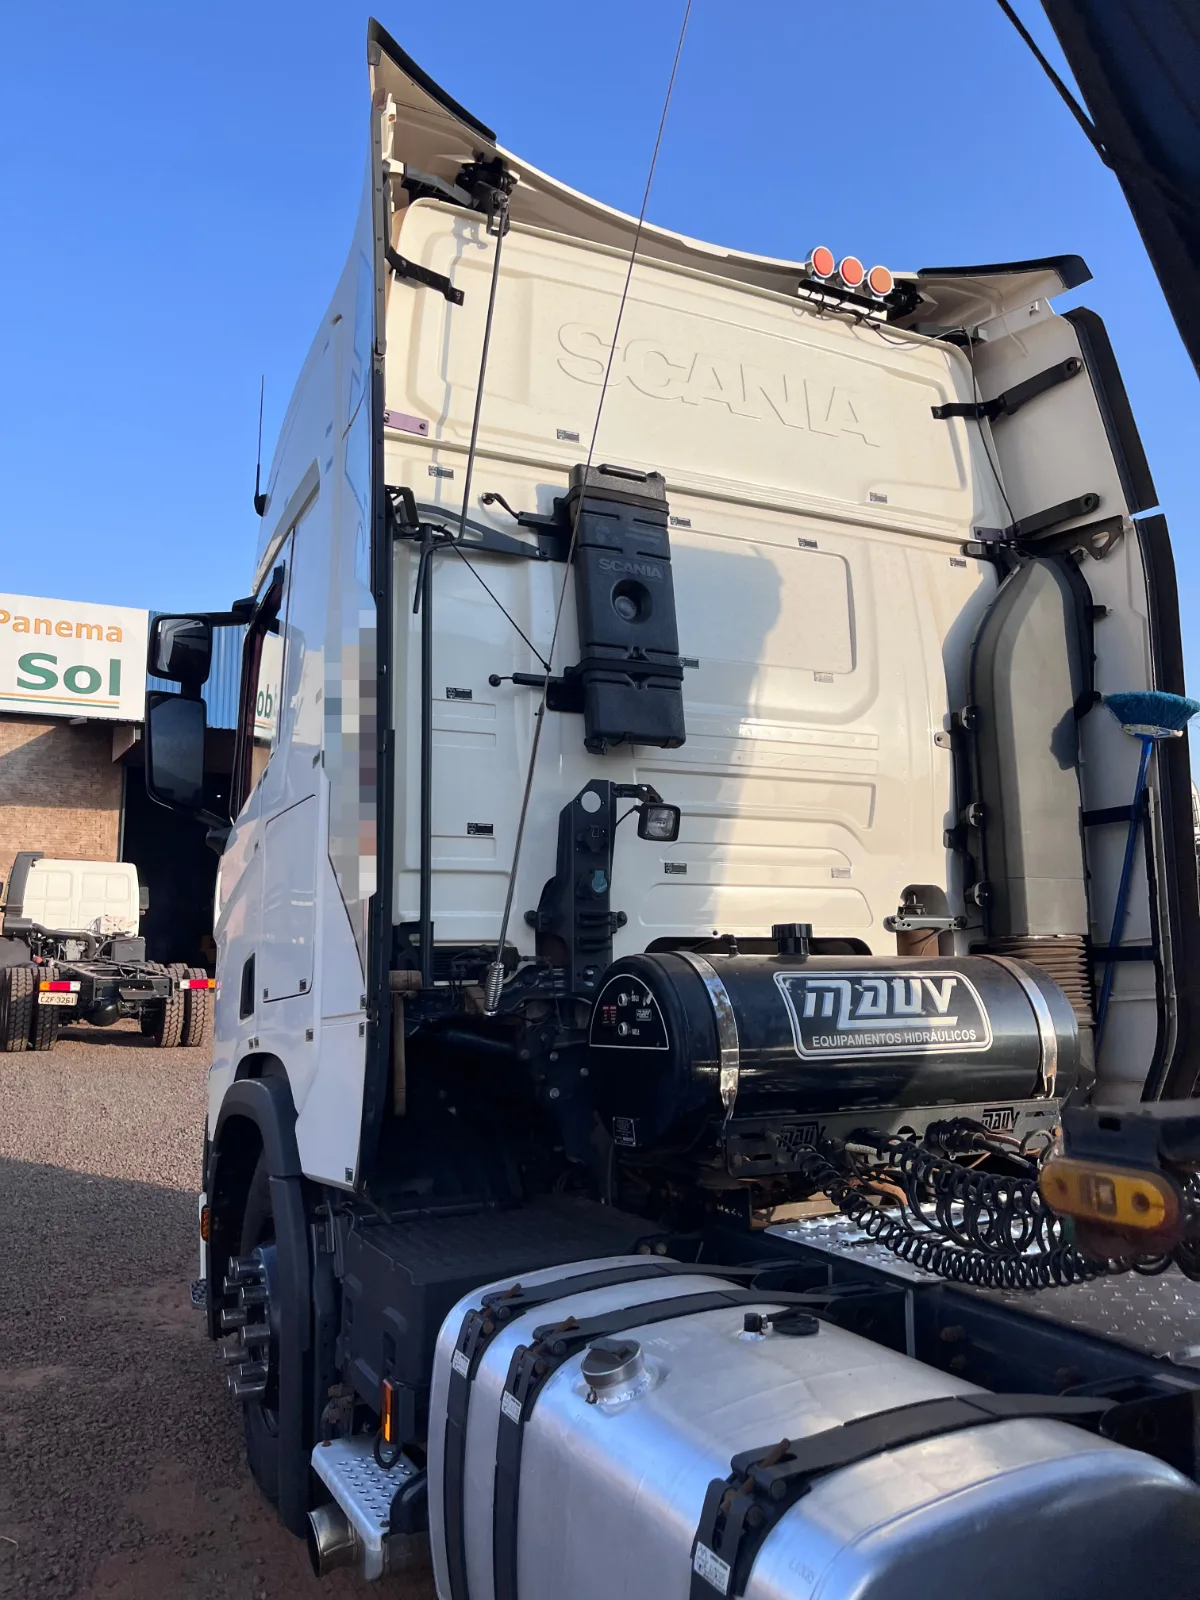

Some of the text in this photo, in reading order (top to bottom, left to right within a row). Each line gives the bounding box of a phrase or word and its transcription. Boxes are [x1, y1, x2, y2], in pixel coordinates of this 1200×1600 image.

[556, 322, 881, 448] SCANIA
[598, 557, 664, 579] SCANIA
[16, 652, 122, 696] Sol
[812, 1029, 978, 1048] EQUIPAMENTOS HIDRÁULICOS
